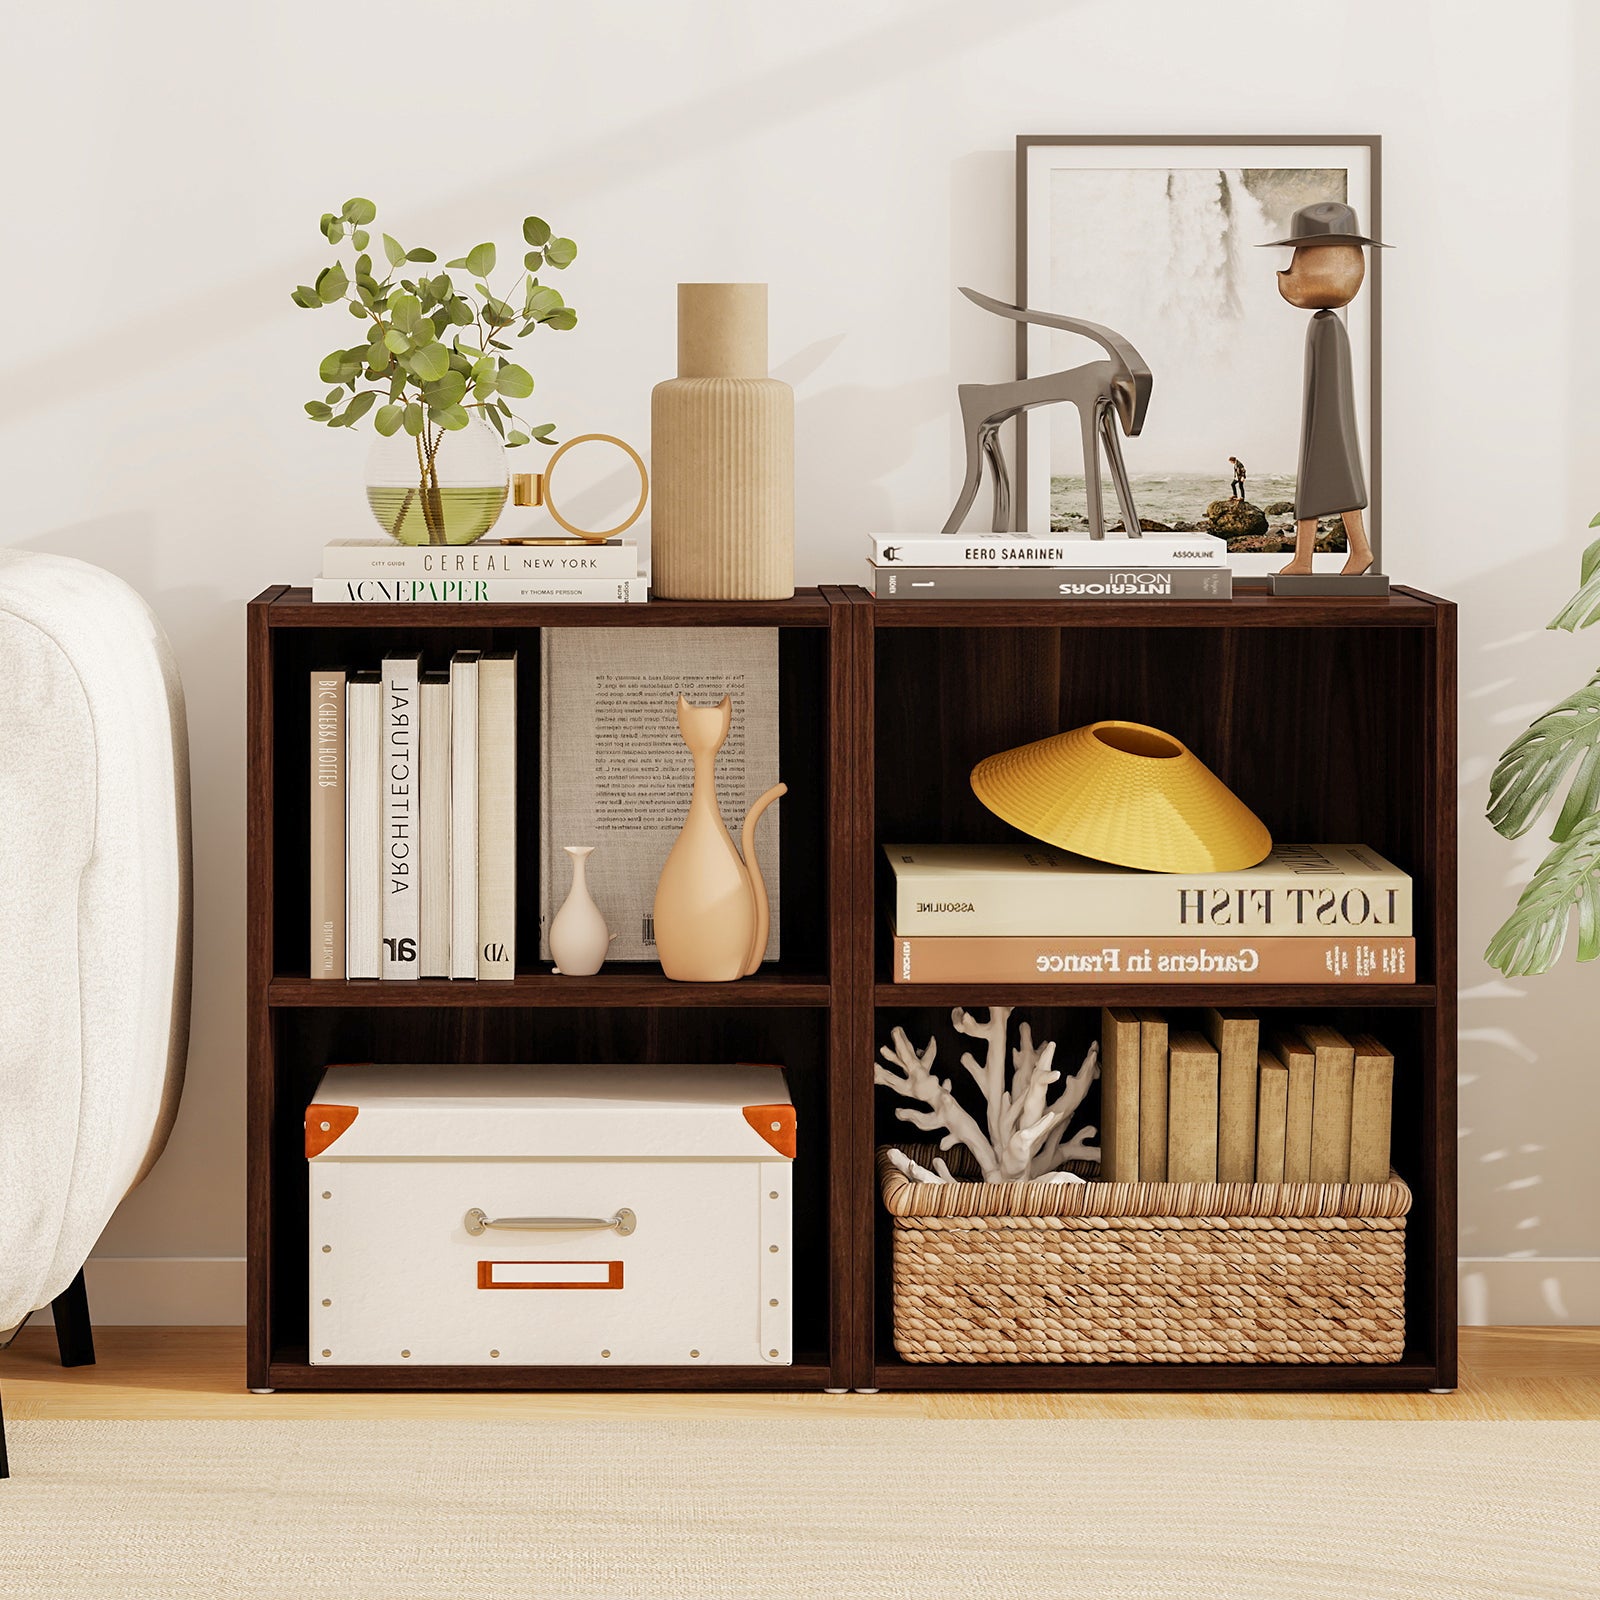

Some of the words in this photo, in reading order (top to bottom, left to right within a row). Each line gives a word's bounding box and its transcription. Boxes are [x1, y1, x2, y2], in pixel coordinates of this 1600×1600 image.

[965, 548, 996, 560] EERO
[1001, 548, 1063, 560] SAARINEN
[1172, 550, 1214, 558] ASSOULINE
[424, 554, 510, 571] CEREAL
[523, 559, 554, 569] NEW
[561, 559, 597, 569] YORK
[1109, 573, 1171, 584] NOW!
[345, 581, 489, 602] ACNEPAPER
[1059, 583, 1171, 594] INTERIORS
